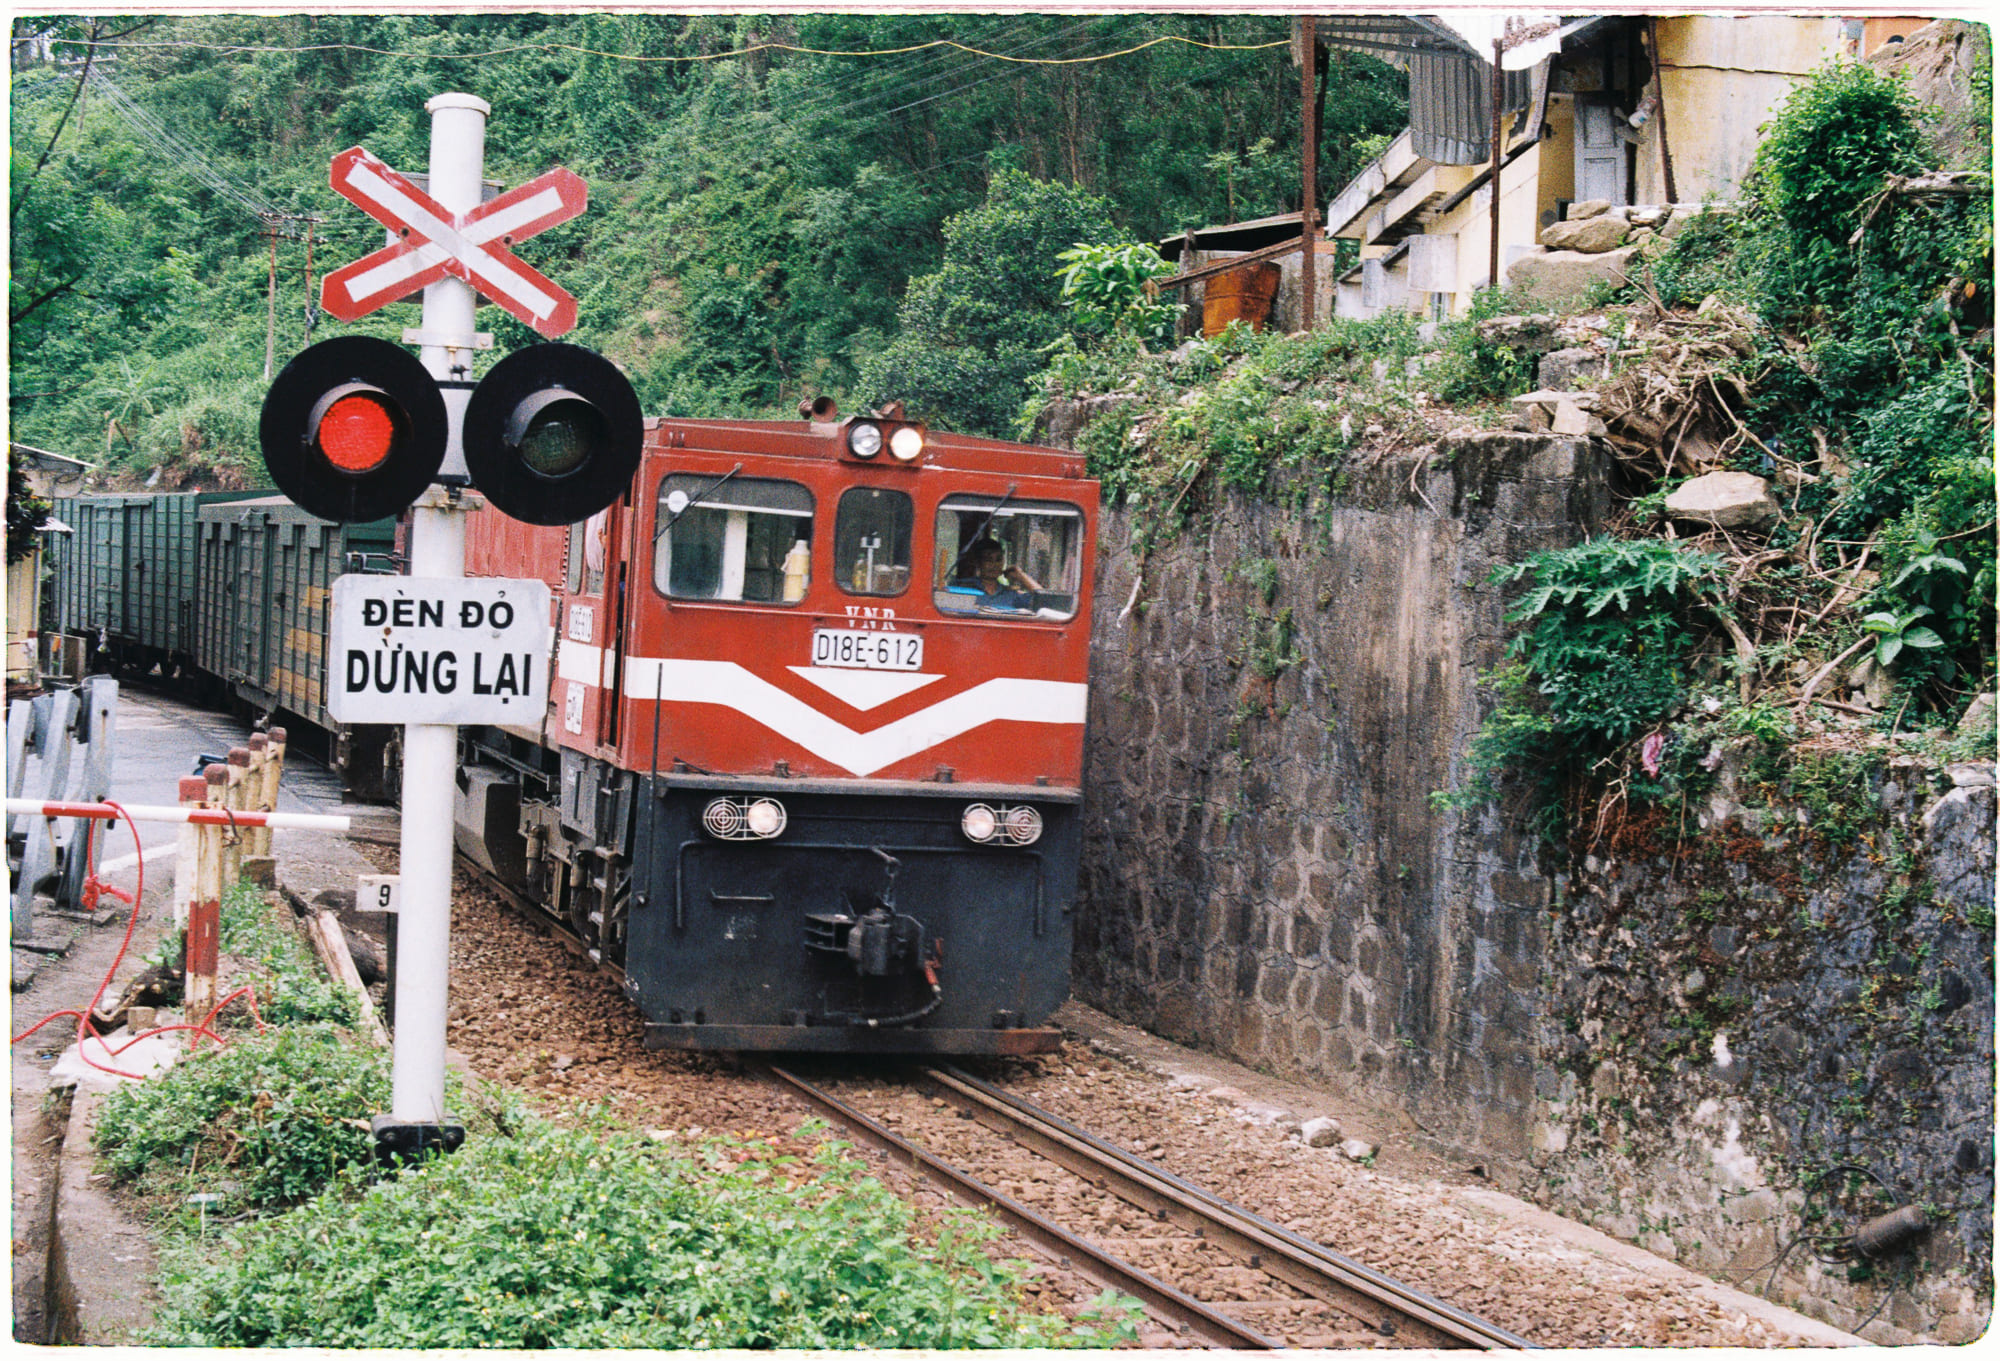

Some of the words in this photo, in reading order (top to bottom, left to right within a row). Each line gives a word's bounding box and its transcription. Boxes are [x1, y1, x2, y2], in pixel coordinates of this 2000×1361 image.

[361, 589, 444, 627] ĐÈN
[459, 590, 514, 629] ĐỎ
[845, 605, 897, 631] VNR
[817, 633, 919, 666] D18E-612
[346, 638, 457, 694] DỪNG
[473, 652, 532, 704] LẠI
[378, 884, 391, 907] 9
